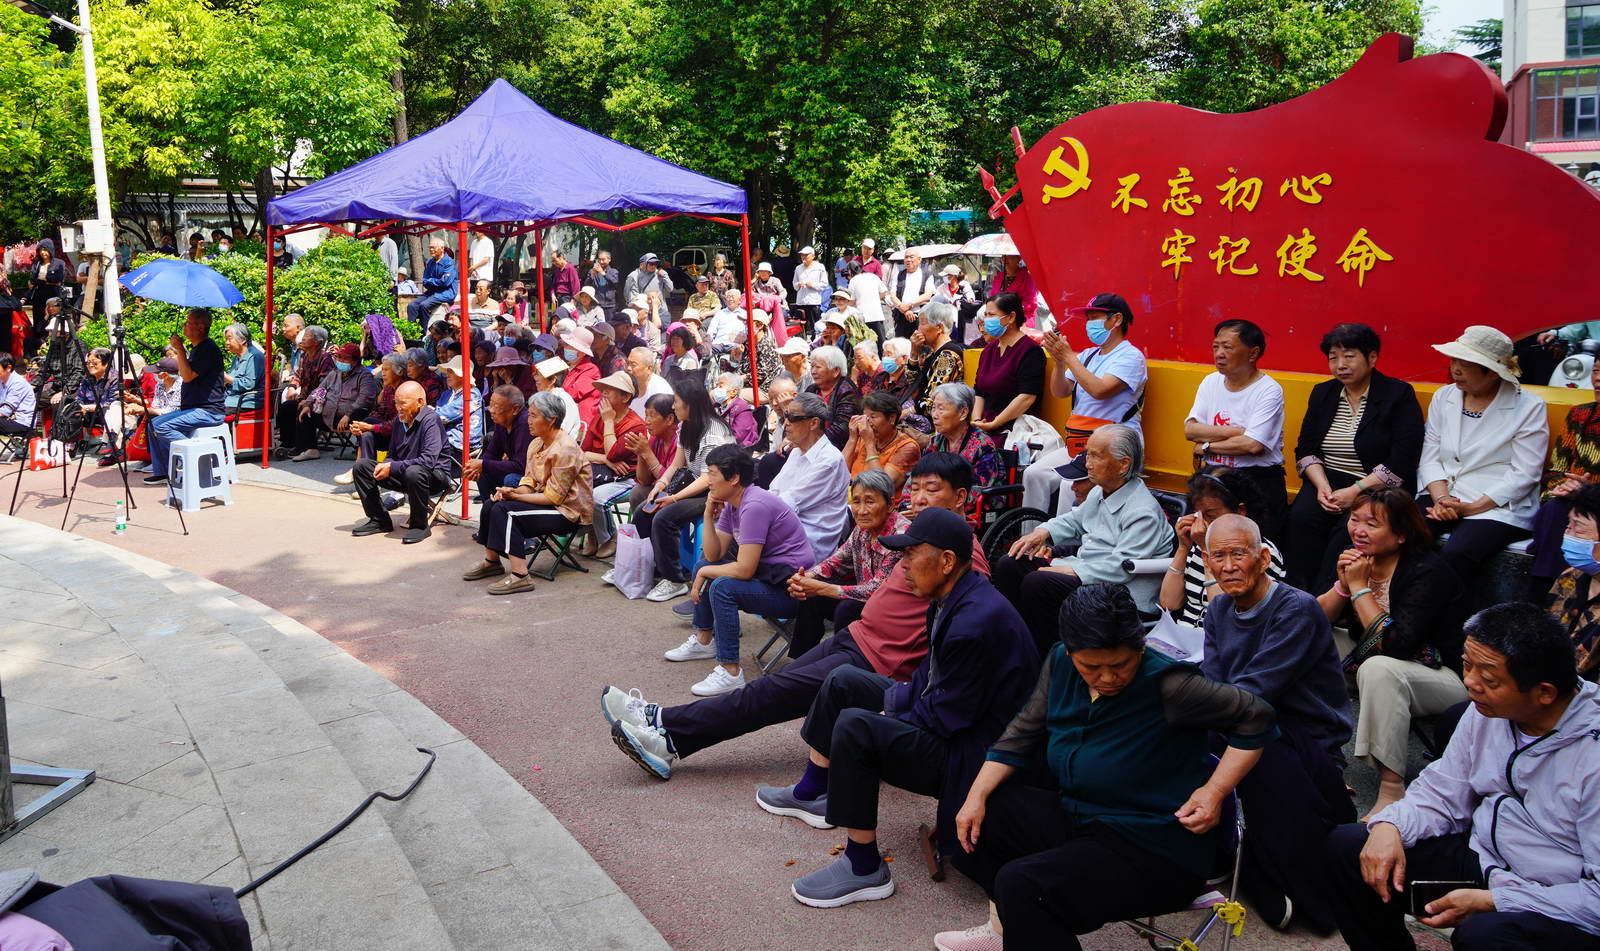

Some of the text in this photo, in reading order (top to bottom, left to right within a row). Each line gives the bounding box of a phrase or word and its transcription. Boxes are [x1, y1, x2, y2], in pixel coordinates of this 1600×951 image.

[1111, 167, 1332, 216] 不忘初心
[1161, 228, 1393, 288] 牢记使命
